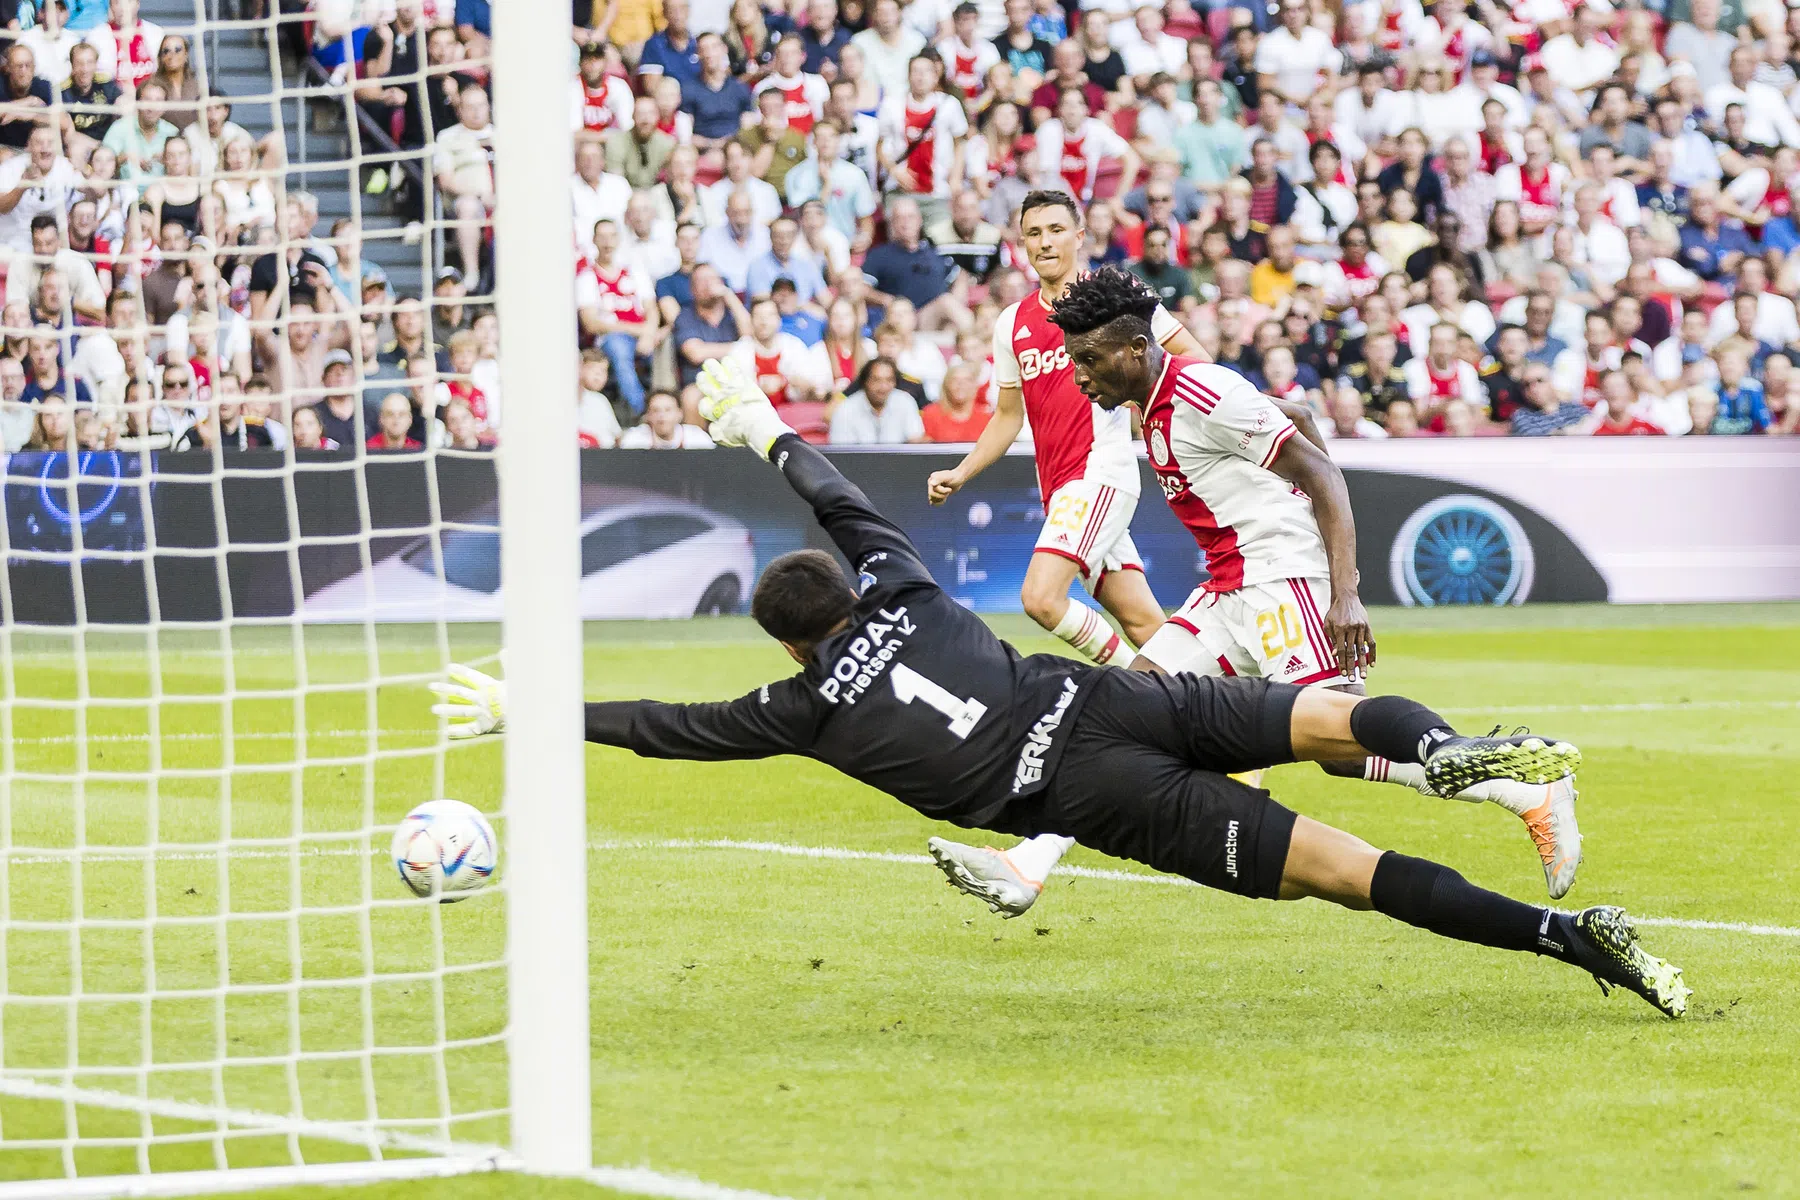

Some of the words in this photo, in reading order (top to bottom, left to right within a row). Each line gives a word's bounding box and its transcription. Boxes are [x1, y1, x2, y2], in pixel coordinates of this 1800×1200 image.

[1018, 345, 1072, 381] Zigg
[1049, 495, 1088, 531] 23
[818, 606, 908, 704] POPAL
[1256, 602, 1304, 660] 20
[1283, 663, 1308, 676] adidas
[889, 661, 989, 740] 1
[1225, 819, 1240, 878] Junction
